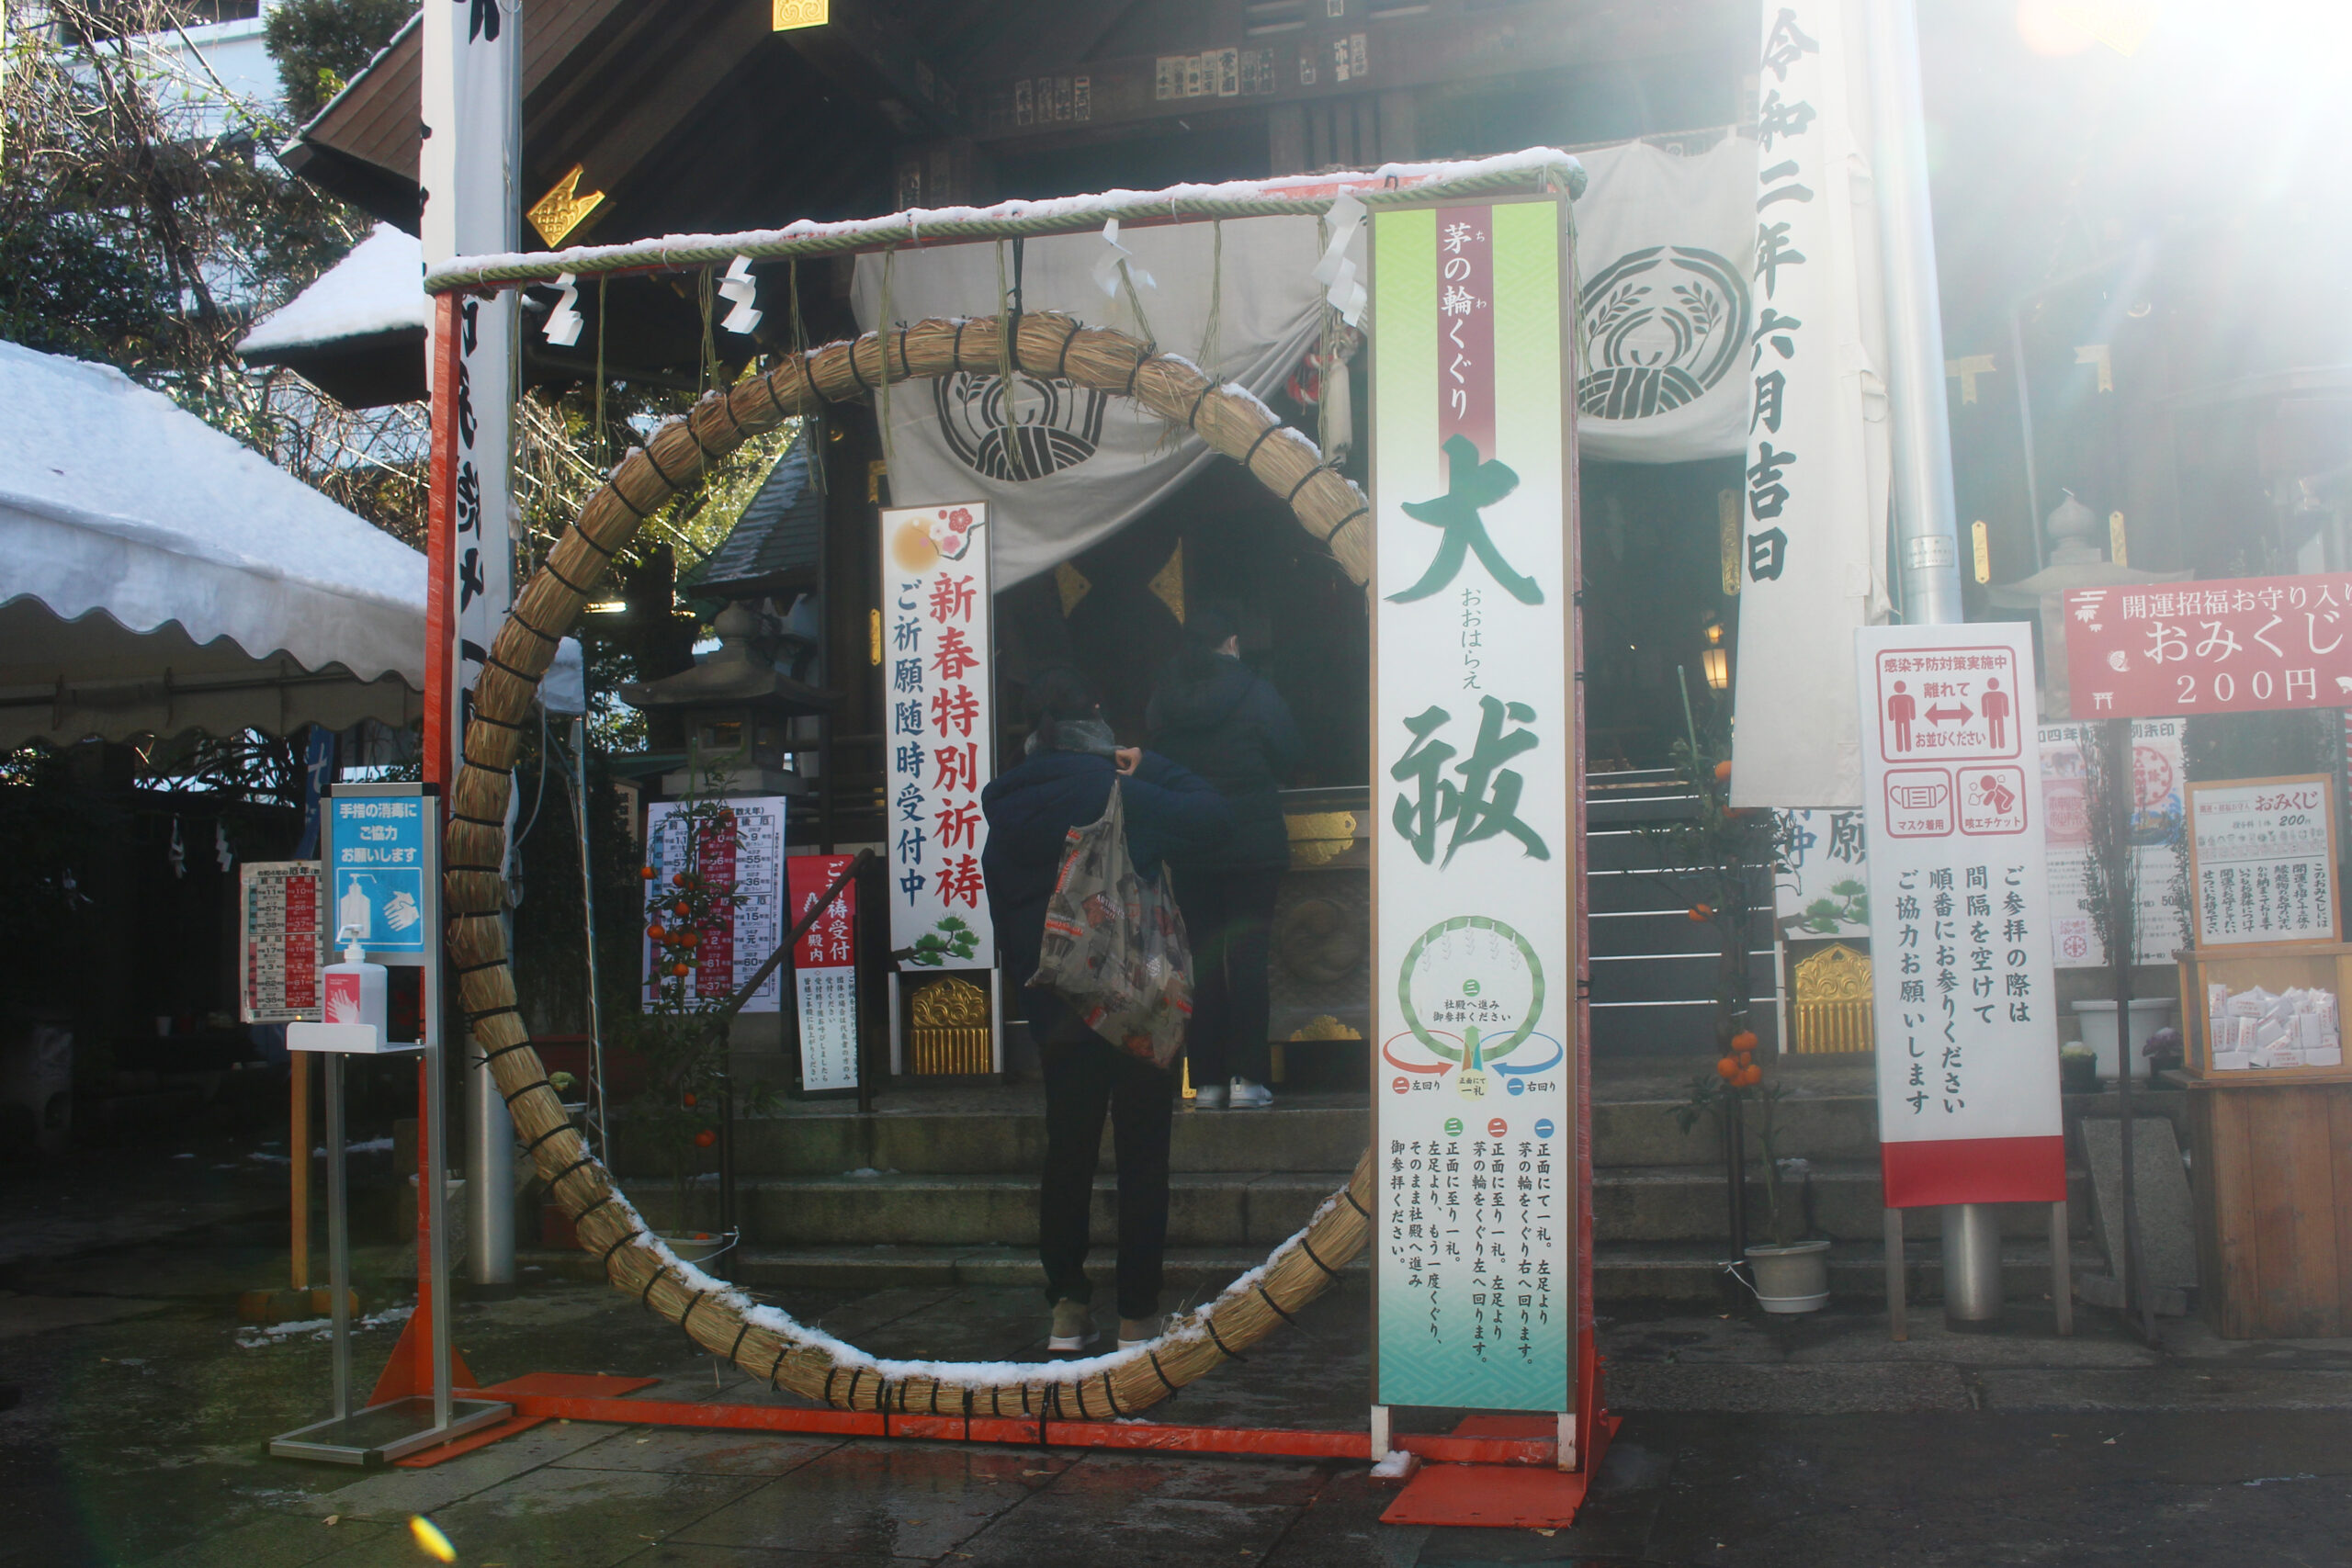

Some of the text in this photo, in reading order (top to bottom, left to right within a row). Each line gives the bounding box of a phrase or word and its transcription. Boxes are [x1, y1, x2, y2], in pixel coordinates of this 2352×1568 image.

[1476, 230, 1486, 243] ち
[1441, 222, 1476, 420] 茅の輪くぐり
[1476, 299, 1487, 310] わ
[1747, 6, 1819, 583] 令和二年六月吉日
[1461, 588, 1482, 690] おおはらえ
[1884, 655, 2007, 672] 感染予防対策実施中
[2143, 610, 2344, 664] おみくじ
[1923, 682, 1971, 699] 離れて
[2177, 668, 2317, 705] 200円
[893, 580, 927, 908] ご祈願随時受付中
[929, 571, 984, 909] 新春特別祈祷
[1916, 730, 1986, 749] お並びください
[339, 803, 417, 819] 手指の消毒に
[359, 826, 398, 841] ご協力
[1897, 819, 1944, 830] マスク着用
[1964, 816, 2021, 829] 咳エチケット
[2255, 791, 2319, 811] おみくじ
[341, 847, 416, 863] お願いします
[2313, 863, 2328, 929] このおみくじには
[1965, 865, 1996, 1024] 間隔を空けて
[2003, 865, 2031, 1023] ご参拝の際は
[1432, 1012, 1511, 1022] 御参拝ください
[1443, 999, 1500, 1010] 社殿へ進み
[1894, 869, 1929, 1115] ご協力お願いします
[1928, 867, 1964, 1113] 順番にお参りください
[1412, 1080, 1441, 1091] 左回り
[1461, 1085, 1485, 1096] 一礼
[1527, 1081, 1555, 1092] 右回り
[1391, 1140, 1405, 1264] 御参拝ください。
[1408, 1140, 1423, 1288] そのまま社殿へ進み
[1445, 1141, 1461, 1262] 正面に至り一礼。
[1490, 1141, 1506, 1264] 正面に至り一礼。
[1536, 1143, 1552, 1247] 正面にて一礼。
[1472, 1141, 1487, 1362] 茅の輪をくぐり左へ回ります。
[1518, 1141, 1532, 1364] 茅の輪をくぐり右へ回ります。
[1490, 1275, 1506, 1341] 左足より
[1536, 1259, 1551, 1325] 左足より
